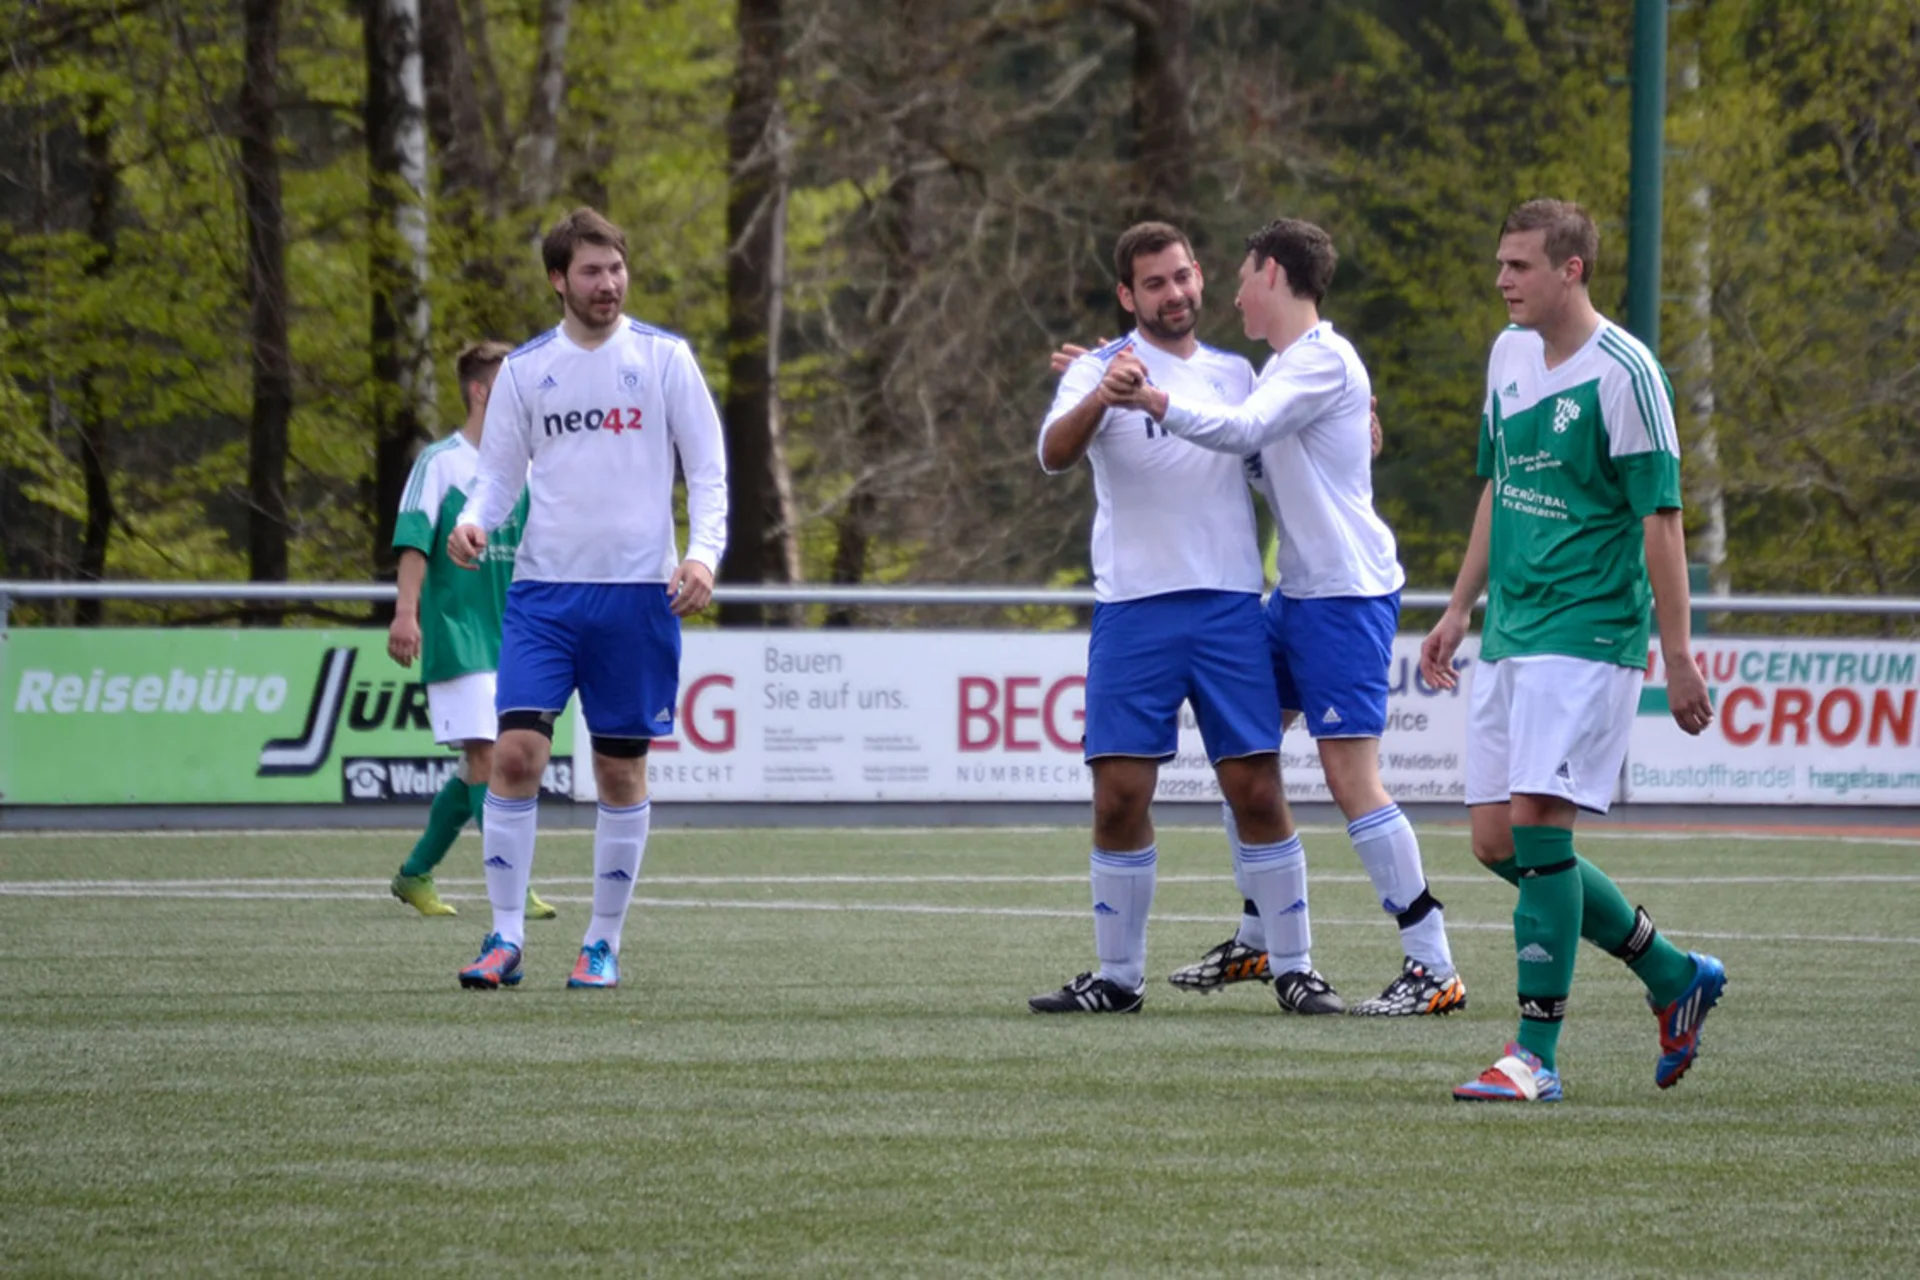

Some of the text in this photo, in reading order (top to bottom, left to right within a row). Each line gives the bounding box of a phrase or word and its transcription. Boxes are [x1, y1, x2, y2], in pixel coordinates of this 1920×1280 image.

[543, 407, 643, 436] neo42
[764, 647, 842, 674] Bauen
[14, 669, 287, 713] Reisebüro
[763, 682, 910, 710] Sie auf uns.
[957, 675, 1087, 753] BEG
[1720, 686, 1917, 747] CRON
[1632, 763, 1795, 789] Baustoffhandel
